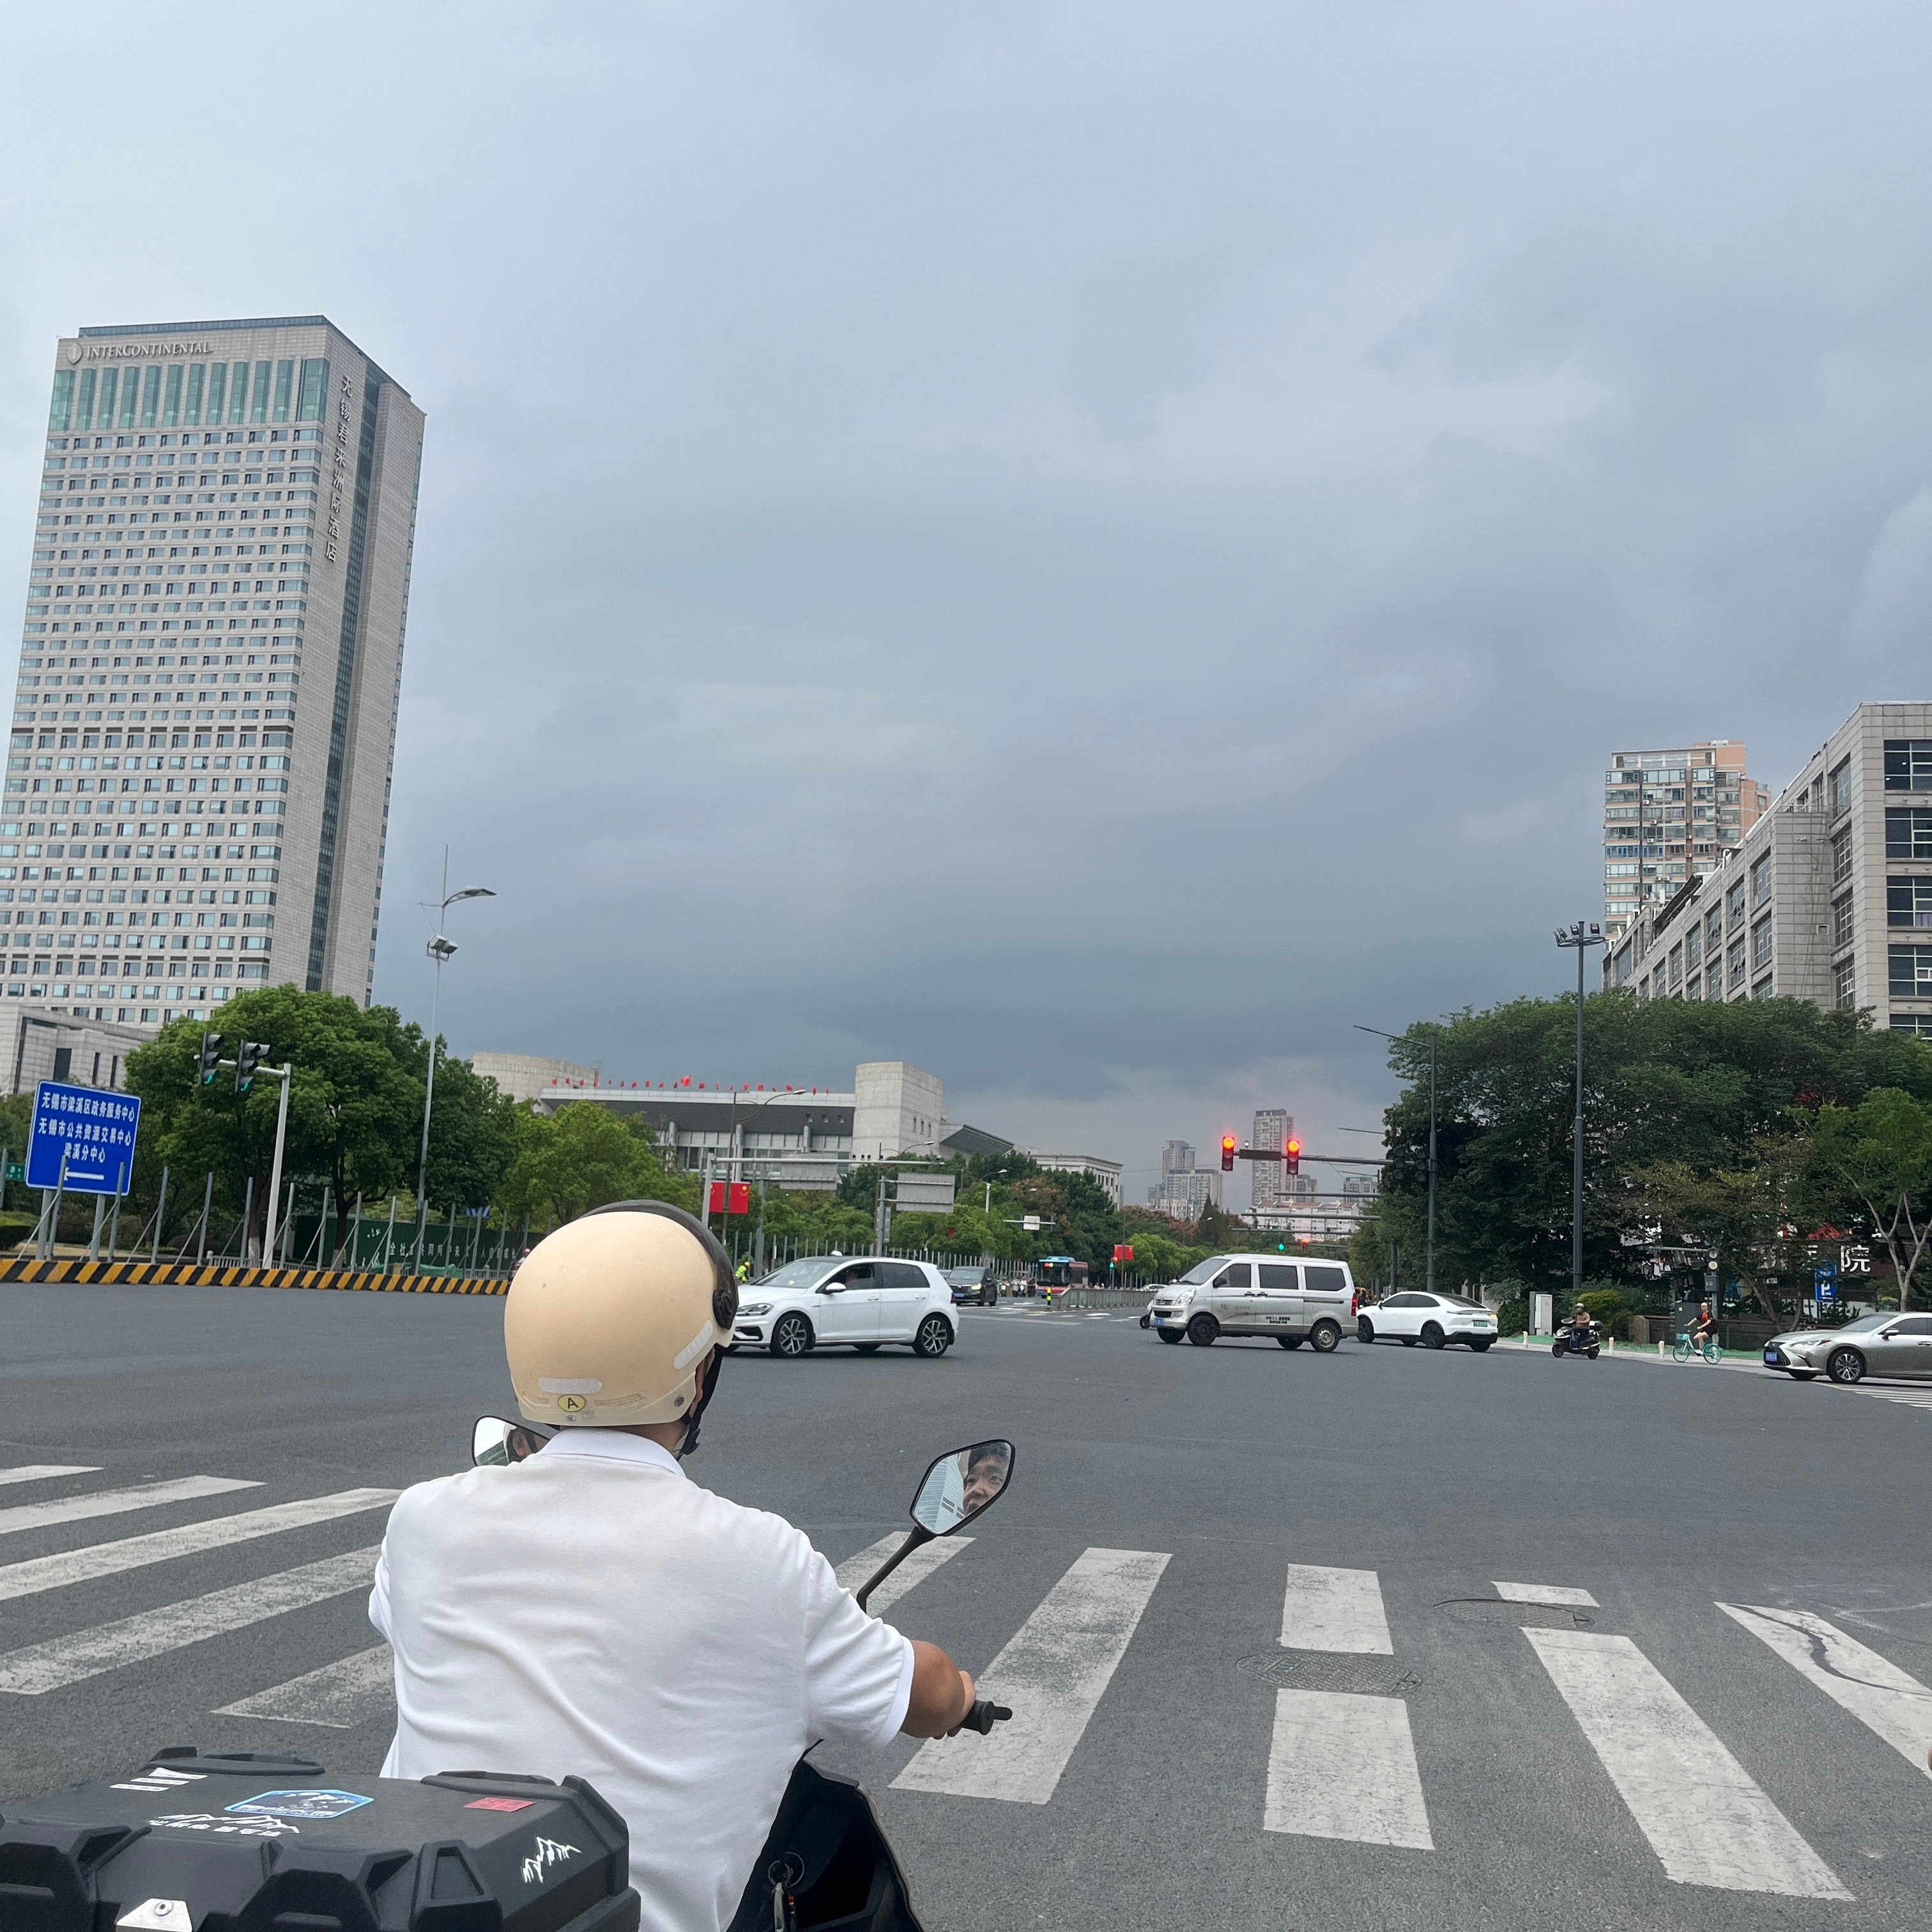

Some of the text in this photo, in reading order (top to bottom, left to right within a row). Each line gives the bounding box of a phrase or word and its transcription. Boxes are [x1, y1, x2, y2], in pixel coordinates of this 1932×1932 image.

[86, 341, 210, 358] INTERCONTINENTAL
[326, 374, 353, 562] 无锡君来洲际酒店
[41, 1091, 135, 1122] 无锡市梁溪区政务服务中心
[38, 1117, 132, 1146] 无锡市公共资源交易中心
[65, 1142, 105, 1163] 梁溪分中心
[567, 1397, 579, 1409] A
